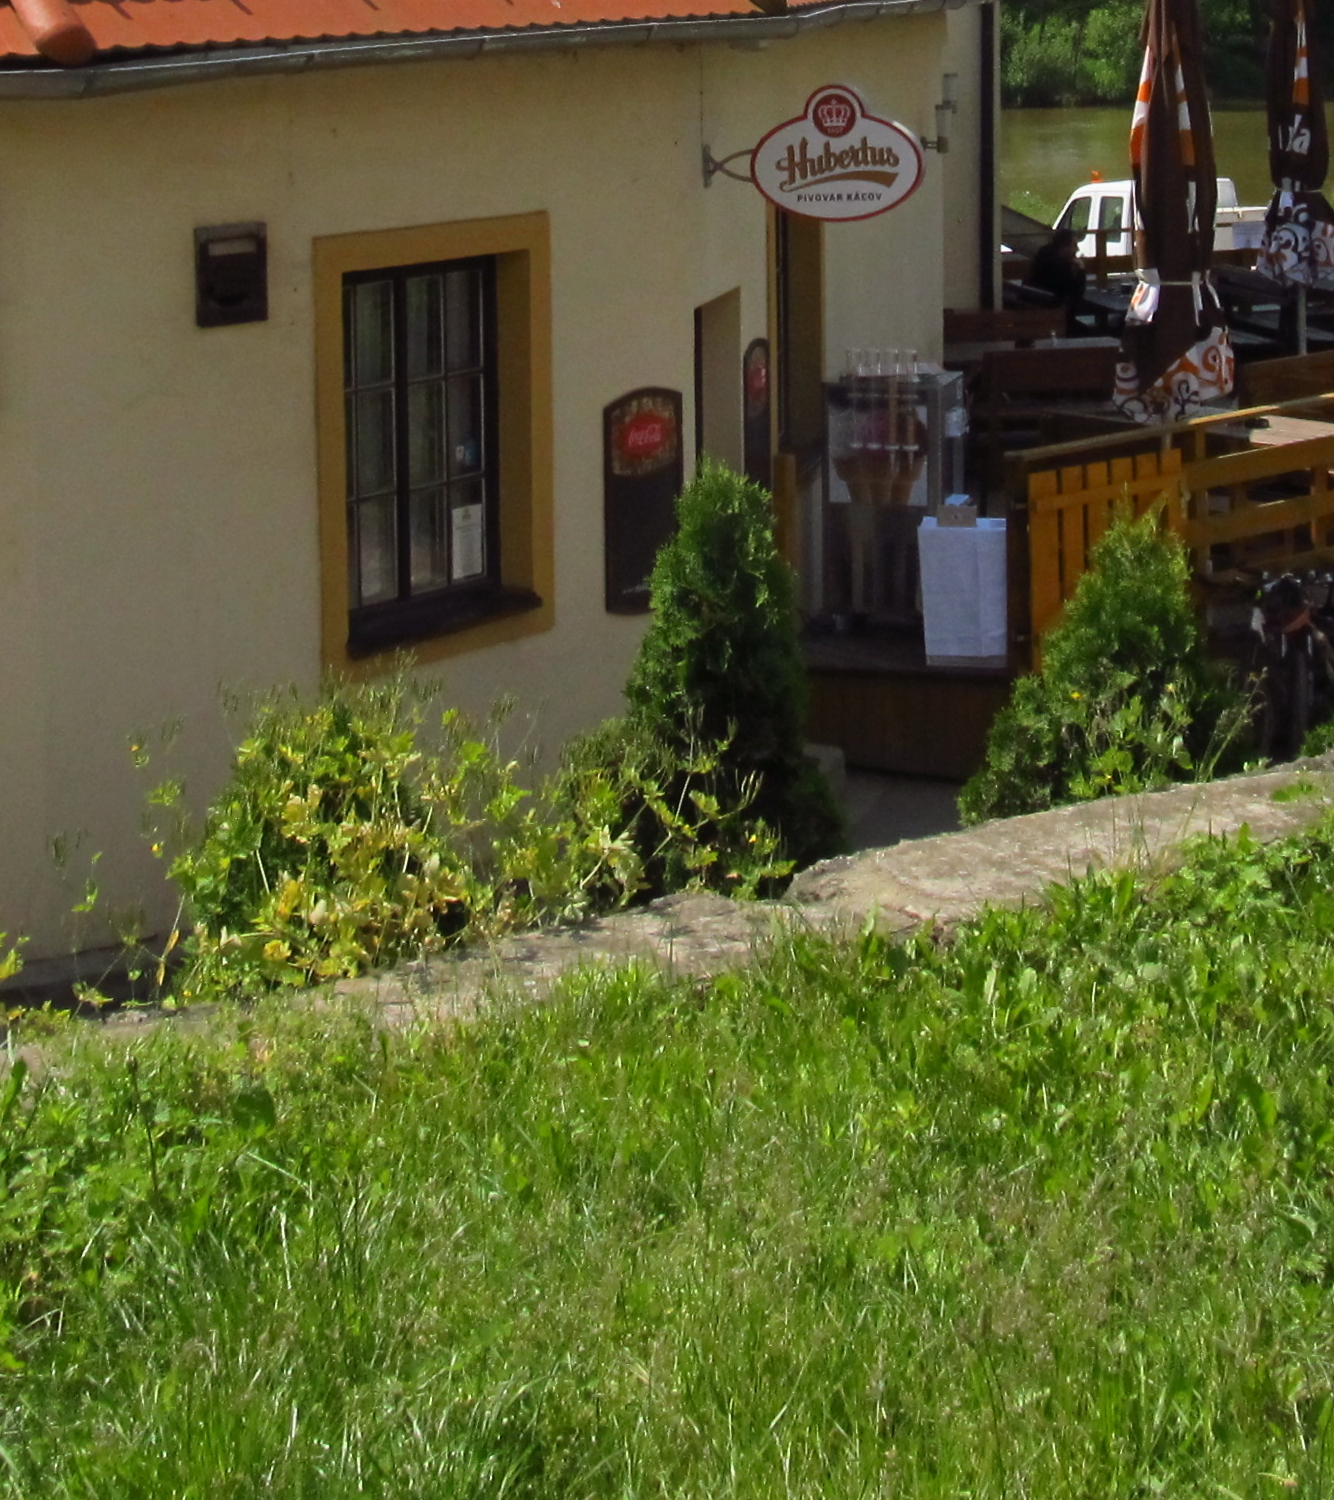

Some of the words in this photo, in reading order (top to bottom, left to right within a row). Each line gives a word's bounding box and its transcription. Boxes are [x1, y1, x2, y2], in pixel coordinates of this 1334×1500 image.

[775, 136, 900, 186] Hubertus
[797, 193, 844, 203] PIVOVAR
[846, 192, 883, 202] KÁCOV
